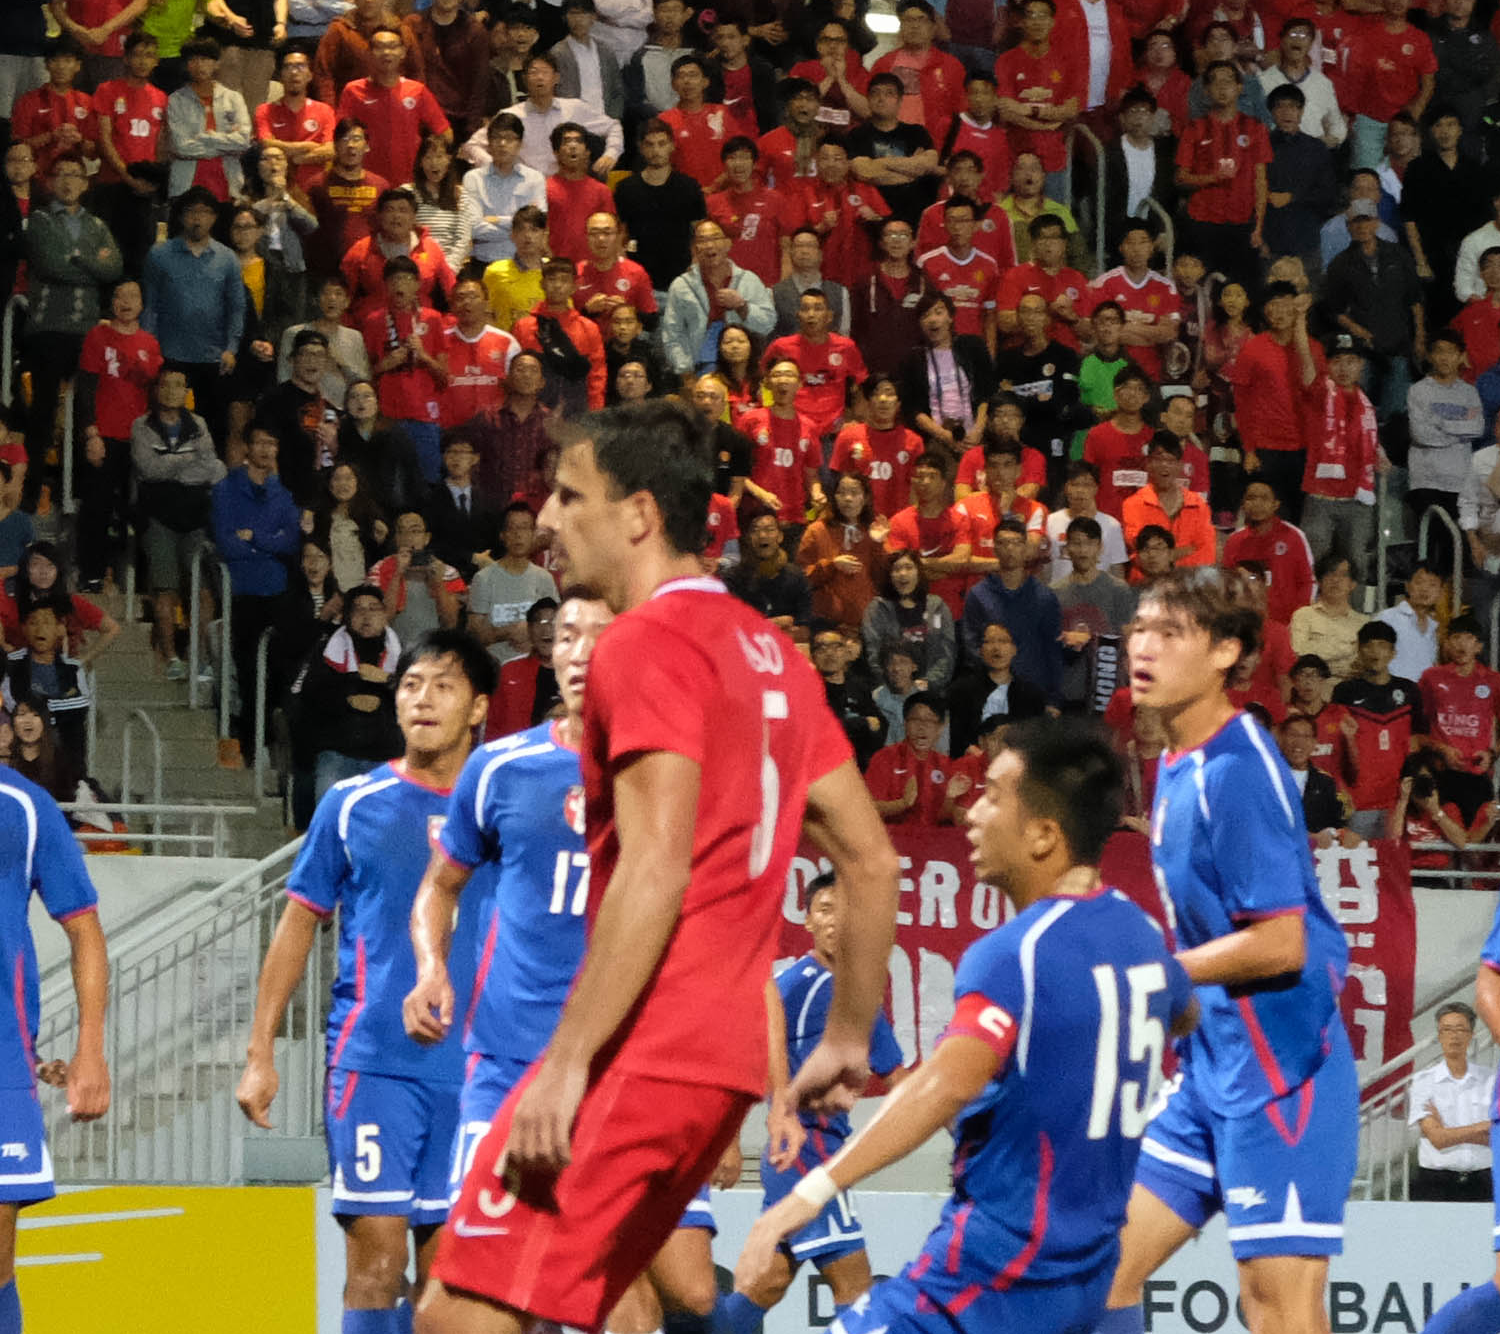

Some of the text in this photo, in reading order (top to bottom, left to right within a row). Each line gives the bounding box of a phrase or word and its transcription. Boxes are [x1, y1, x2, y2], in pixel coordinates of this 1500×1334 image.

[774, 447, 794, 468] 10
[870, 461, 893, 481] 10
[549, 850, 591, 917] 17
[1085, 962, 1168, 1141] 15
[354, 1123, 381, 1183] 5
